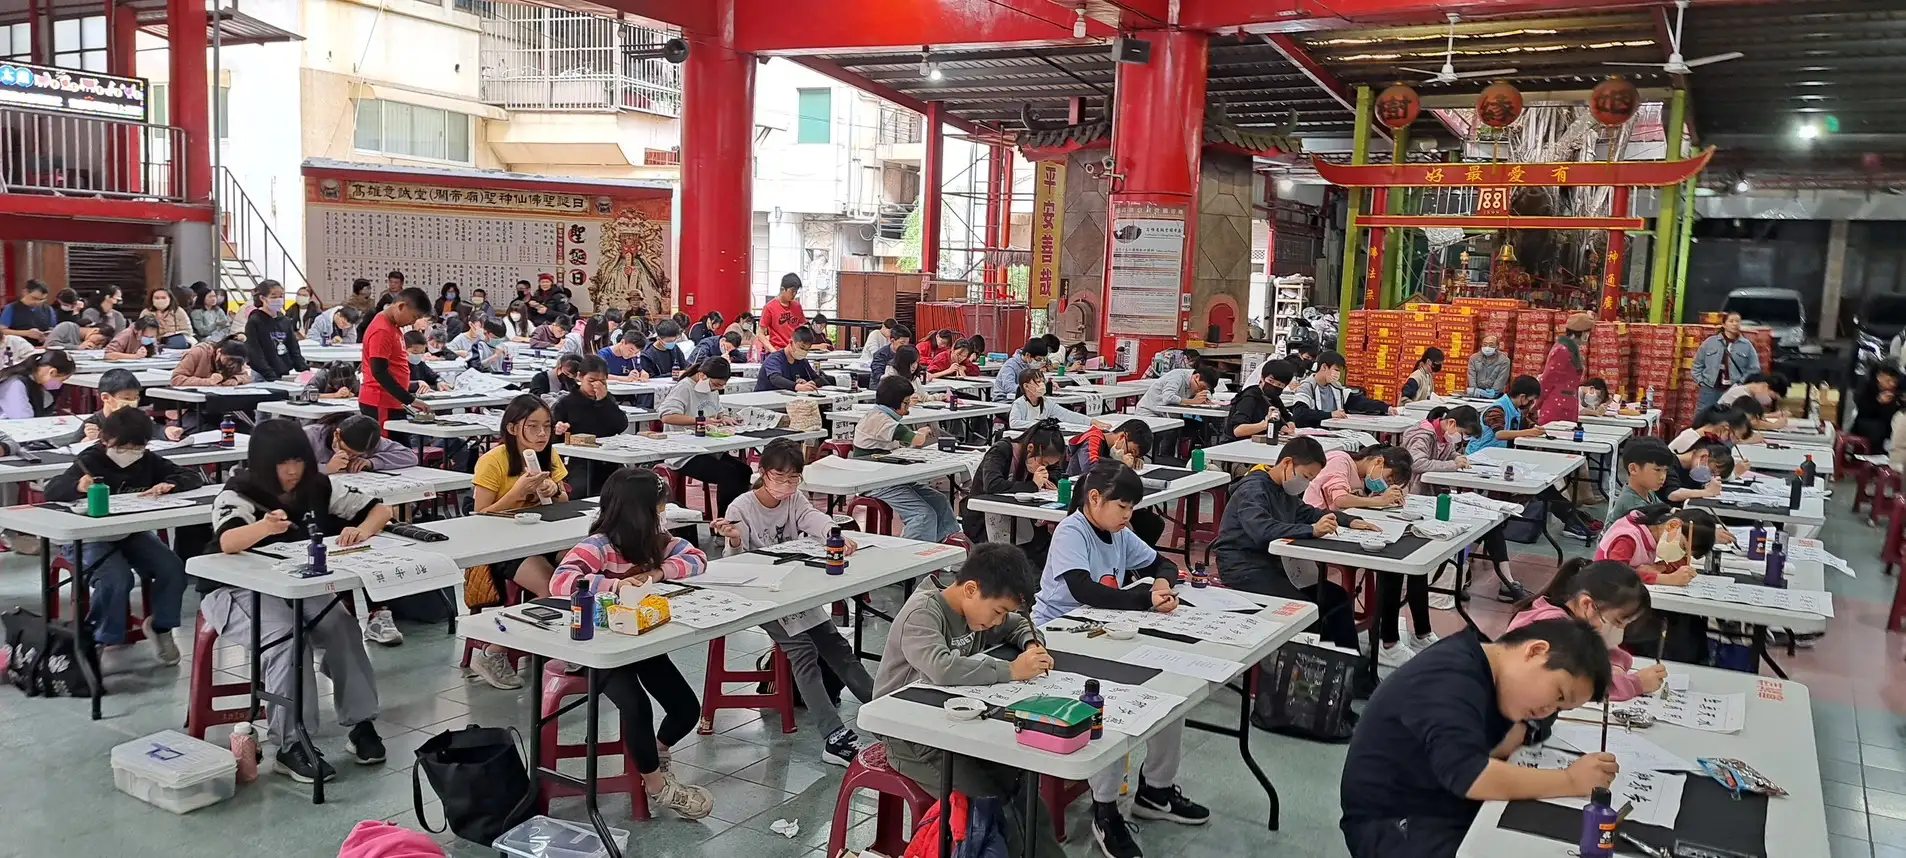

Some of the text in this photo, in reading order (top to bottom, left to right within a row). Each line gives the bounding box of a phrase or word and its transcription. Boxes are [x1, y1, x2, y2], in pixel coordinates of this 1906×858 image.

[568, 223, 588, 286] 聖誕日
[1040, 166, 1057, 297] 平安善哉
